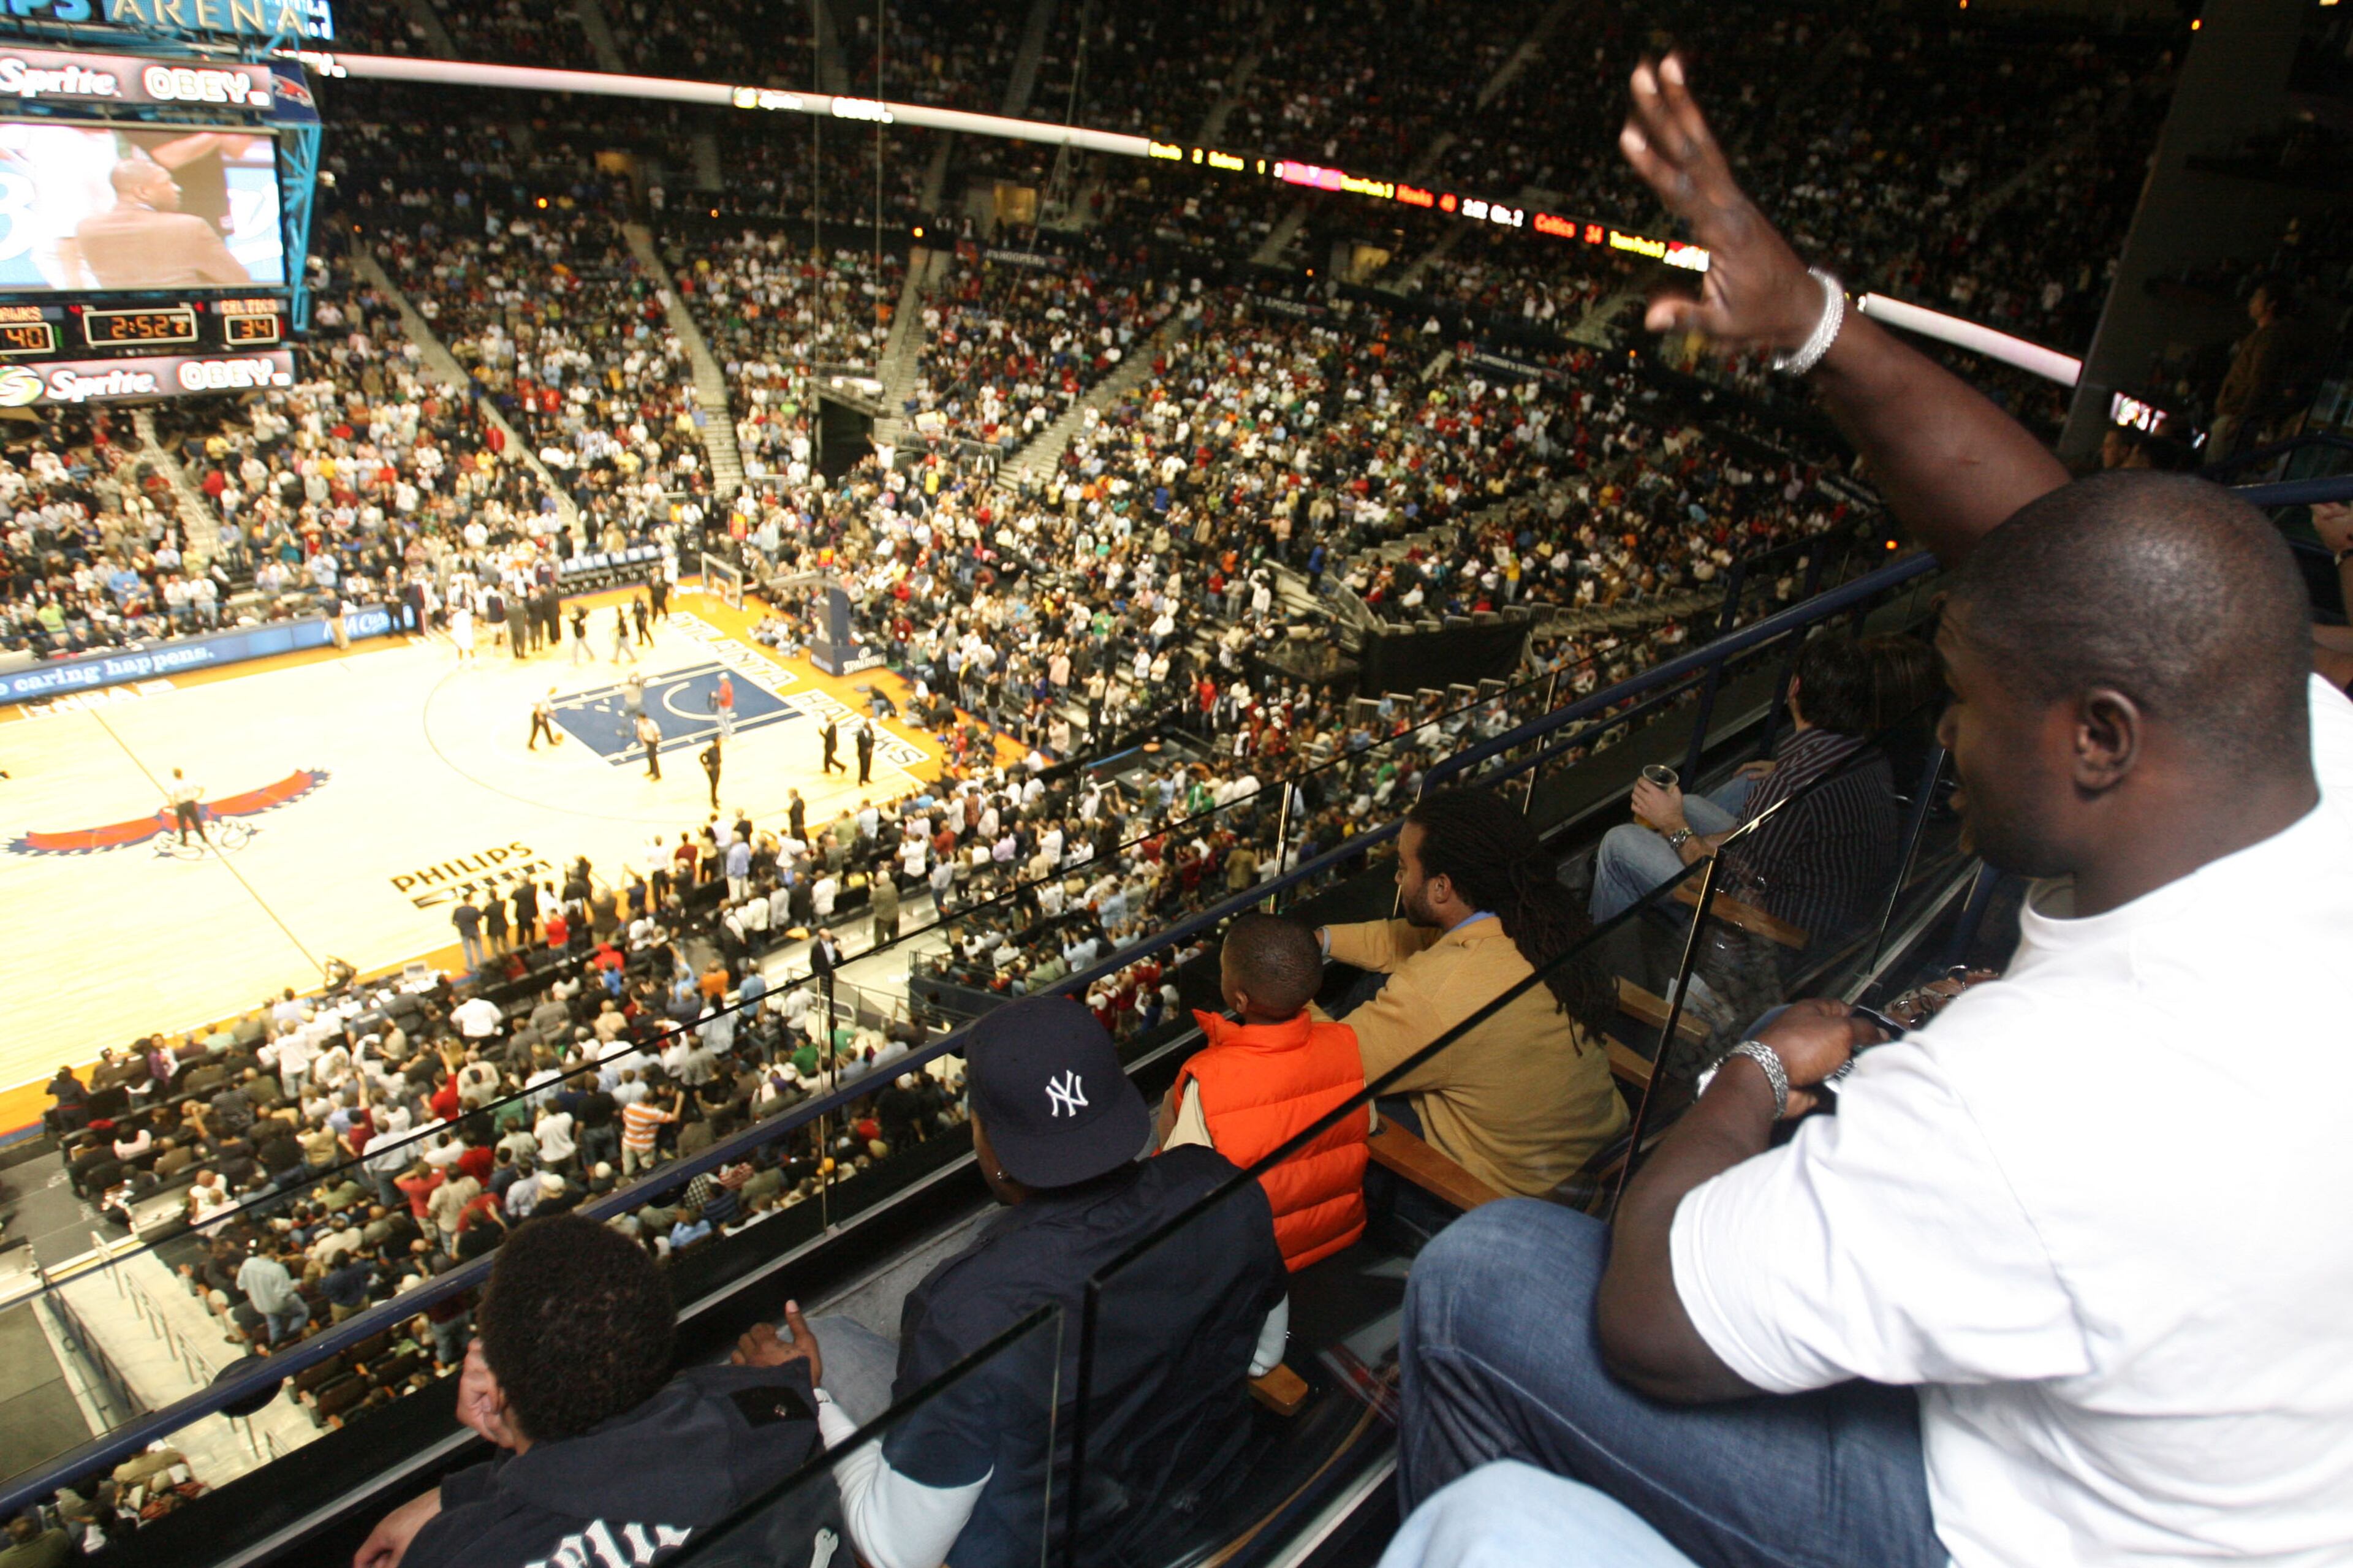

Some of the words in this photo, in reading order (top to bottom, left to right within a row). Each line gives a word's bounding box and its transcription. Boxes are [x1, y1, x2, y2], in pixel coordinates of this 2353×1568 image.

[113, 0, 306, 38] ARENA
[0, 58, 116, 97] Sprite
[1534, 213, 1575, 238] Celtics
[5, 326, 45, 349] 40
[110, 314, 170, 339] 2:52
[240, 319, 271, 338] 34
[47, 368, 154, 403] Sprite
[13, 664, 101, 692] caring
[104, 645, 214, 676] happens.
[390, 841, 533, 893] PHILIPS
[1045, 1069, 1089, 1118] NY
